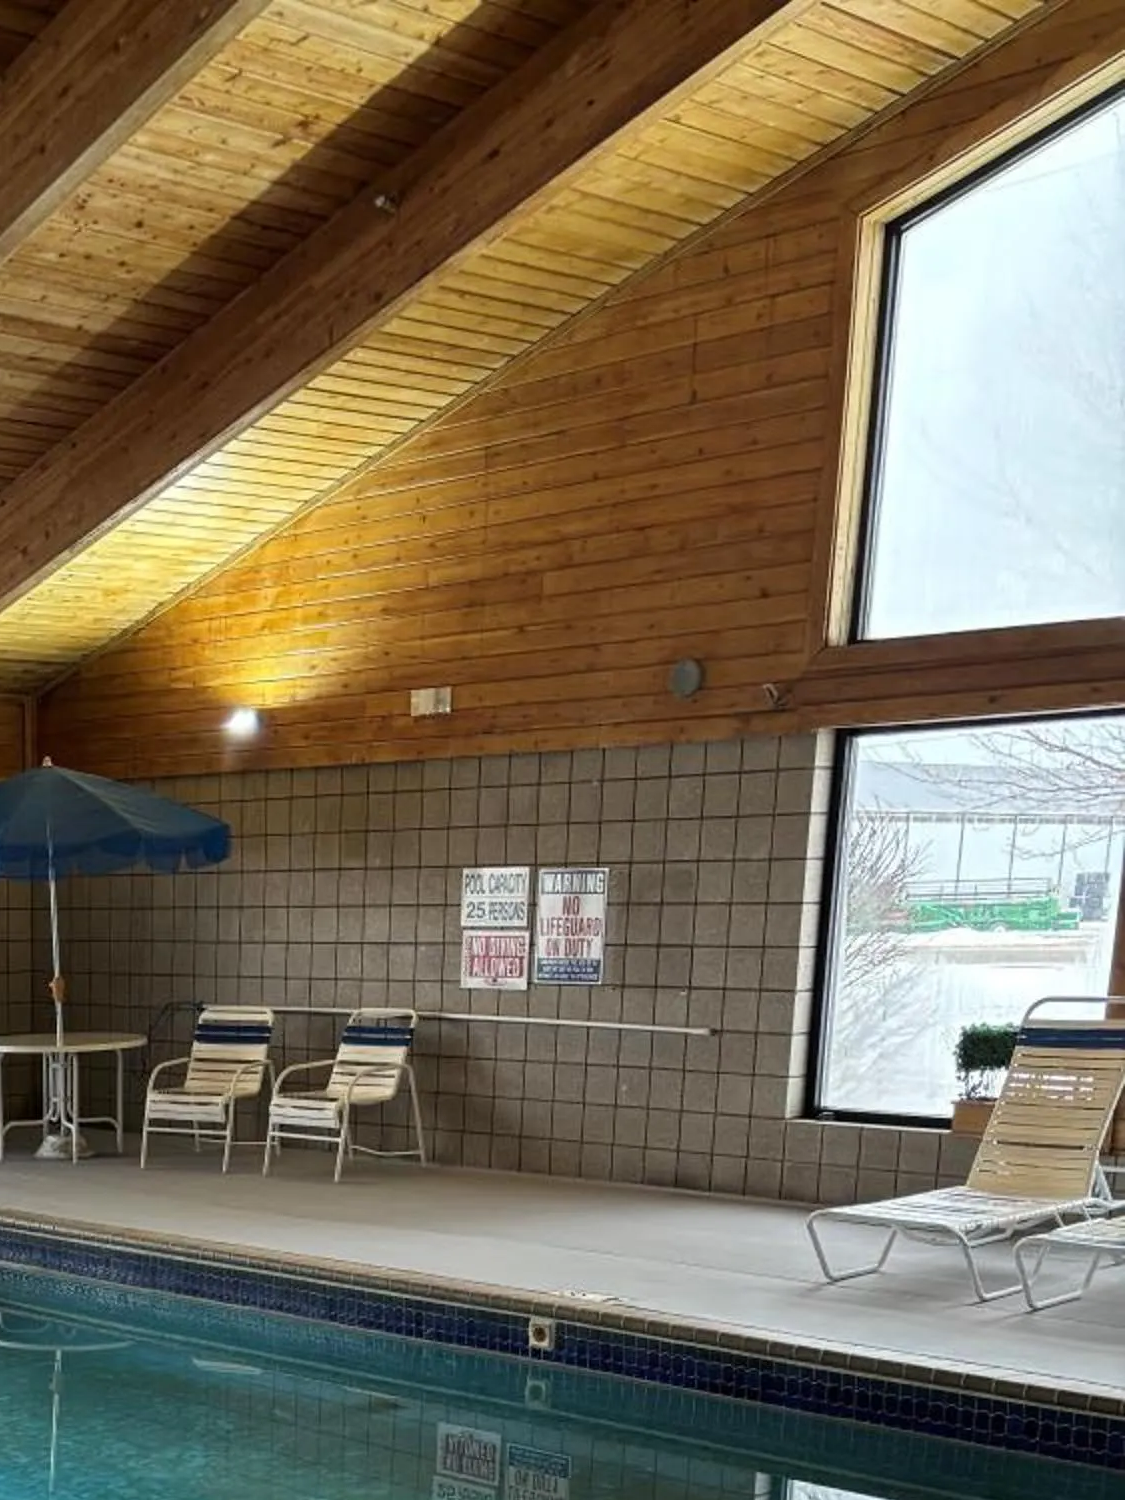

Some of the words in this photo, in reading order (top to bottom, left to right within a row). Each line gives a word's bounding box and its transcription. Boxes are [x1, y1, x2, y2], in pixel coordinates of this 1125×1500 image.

[465, 873, 486, 894] POOL
[489, 872, 527, 894] CAPACITY
[543, 873, 603, 892] WARNING
[466, 901, 485, 918] 25
[489, 901, 525, 920] PERSONS
[563, 895, 580, 914] NO
[540, 917, 602, 936] LIFEGUARD
[471, 937, 486, 956] NO
[546, 938, 559, 956] ON
[564, 938, 593, 956] DUTY
[472, 957, 521, 976] ALLOWED
